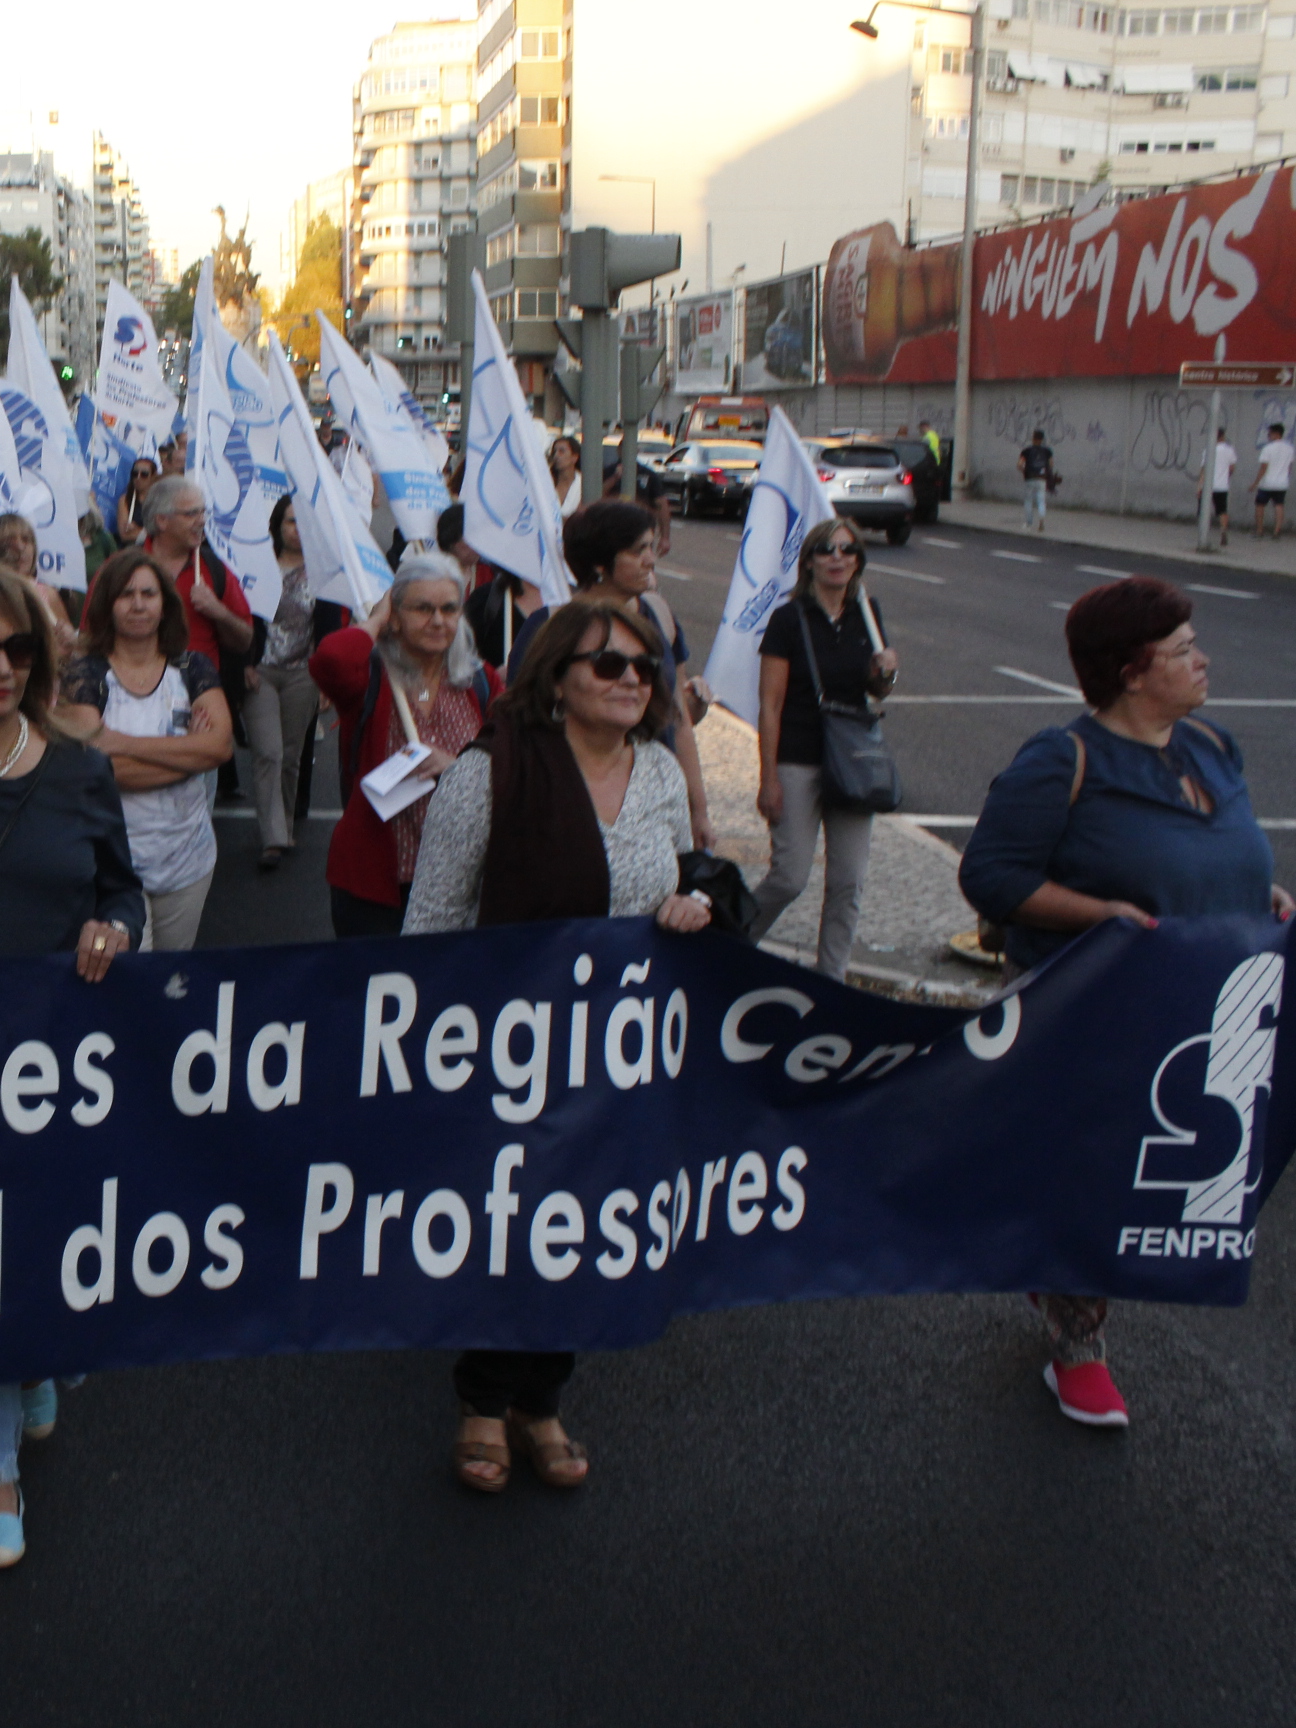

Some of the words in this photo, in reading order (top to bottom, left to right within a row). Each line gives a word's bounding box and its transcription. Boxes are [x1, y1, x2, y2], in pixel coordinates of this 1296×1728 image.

[171, 981, 306, 1117] da
[360, 953, 688, 1124] Região
[720, 986, 1021, 1084] Ceno
[61, 1177, 245, 1312] dos
[299, 1144, 807, 1281] Professores
[1117, 1226, 1257, 1260] FENPRO
